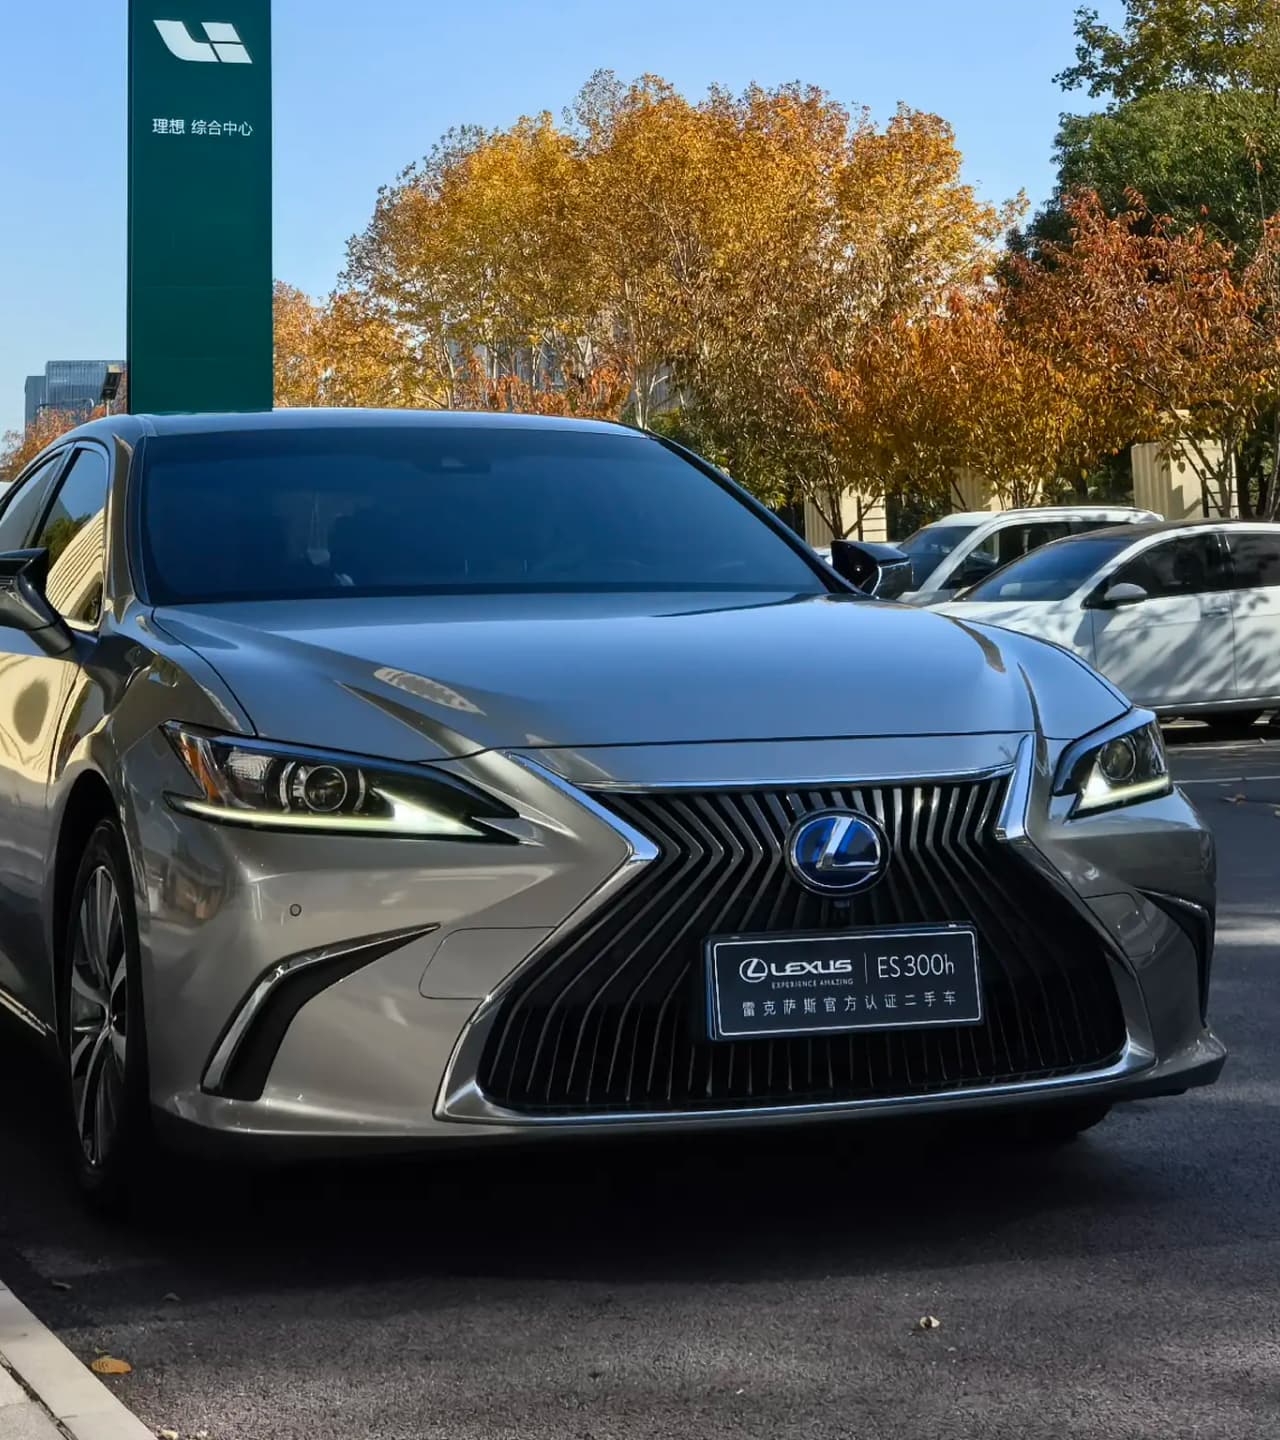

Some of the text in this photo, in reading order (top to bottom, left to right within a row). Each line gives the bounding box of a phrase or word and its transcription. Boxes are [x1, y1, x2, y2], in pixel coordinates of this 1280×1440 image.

[152, 118, 253, 136] 理想 综合中心
[769, 958, 853, 977] LEXUS
[771, 977, 854, 990] EXPERIENCE AMAZING
[741, 990, 957, 1018] 雷克萨斯官方认证二手车
